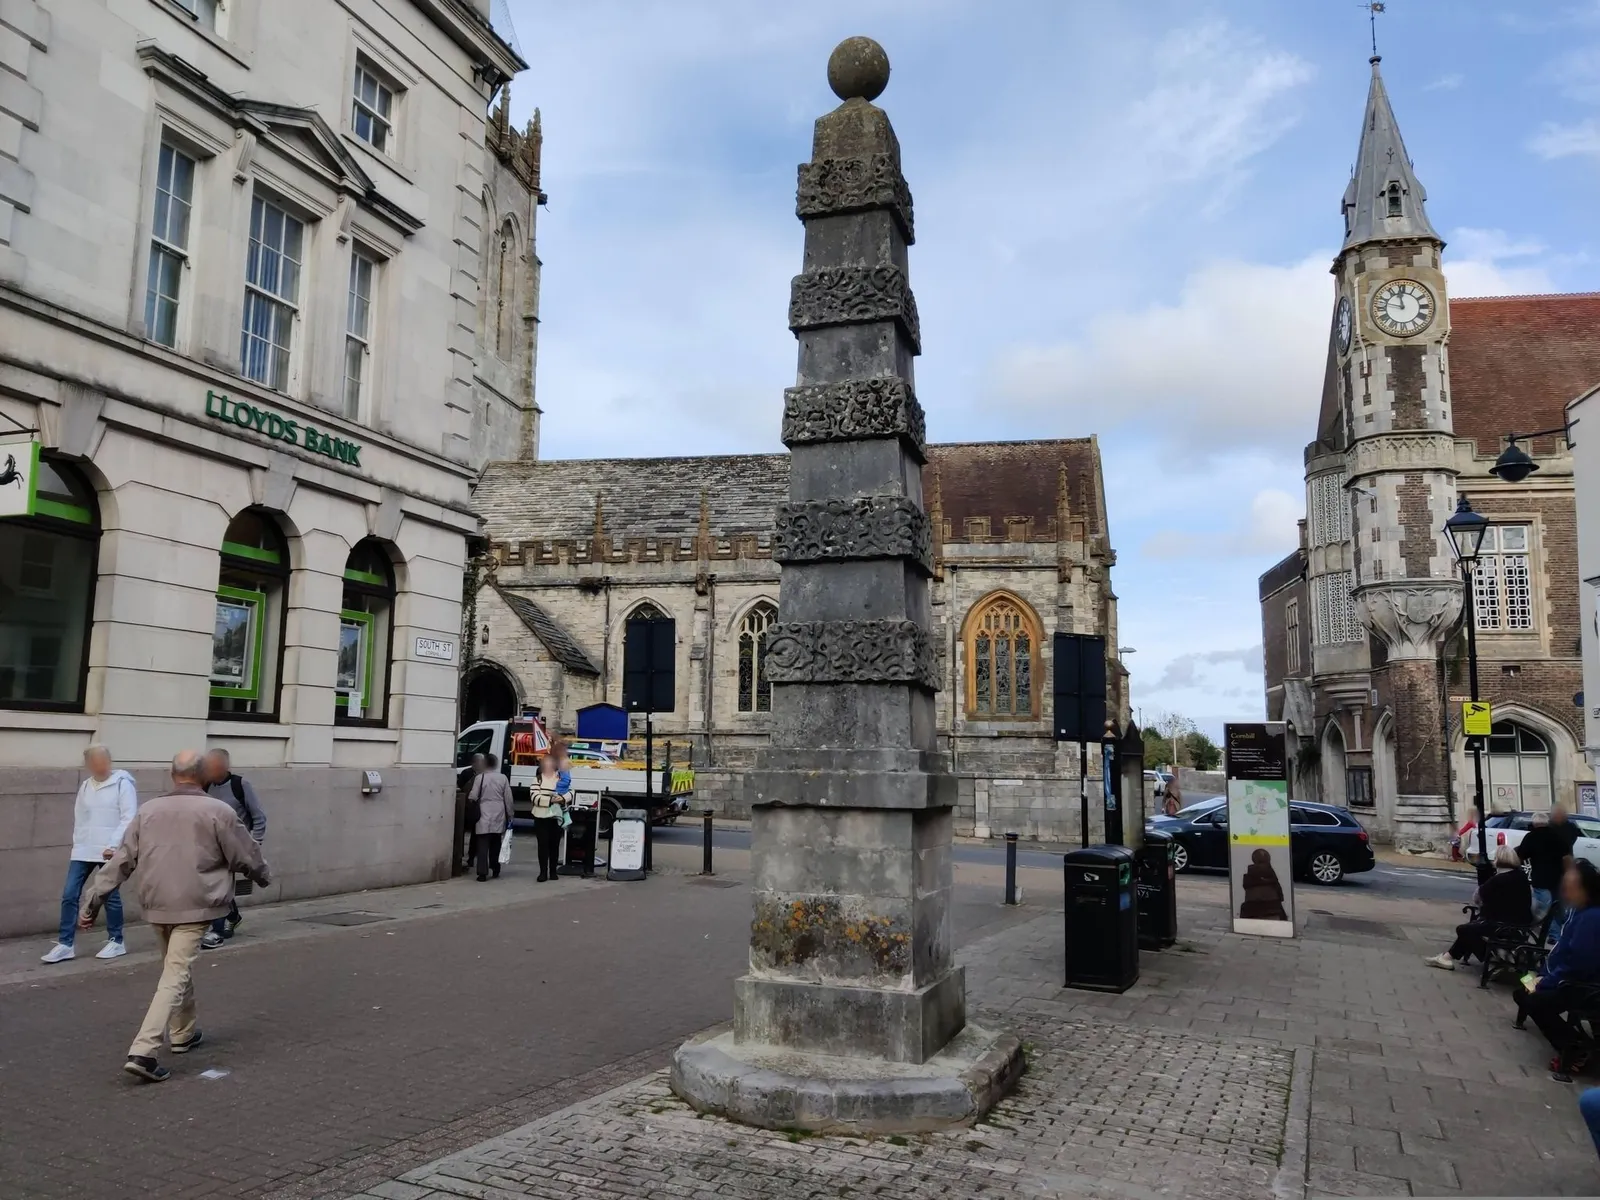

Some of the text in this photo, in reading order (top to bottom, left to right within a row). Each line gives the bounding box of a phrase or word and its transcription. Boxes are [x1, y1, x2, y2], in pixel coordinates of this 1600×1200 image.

[206, 390, 362, 467] LLOYDS BANK
[419, 639, 451, 653] SOUTH ST
[1497, 786, 1515, 797] DA
